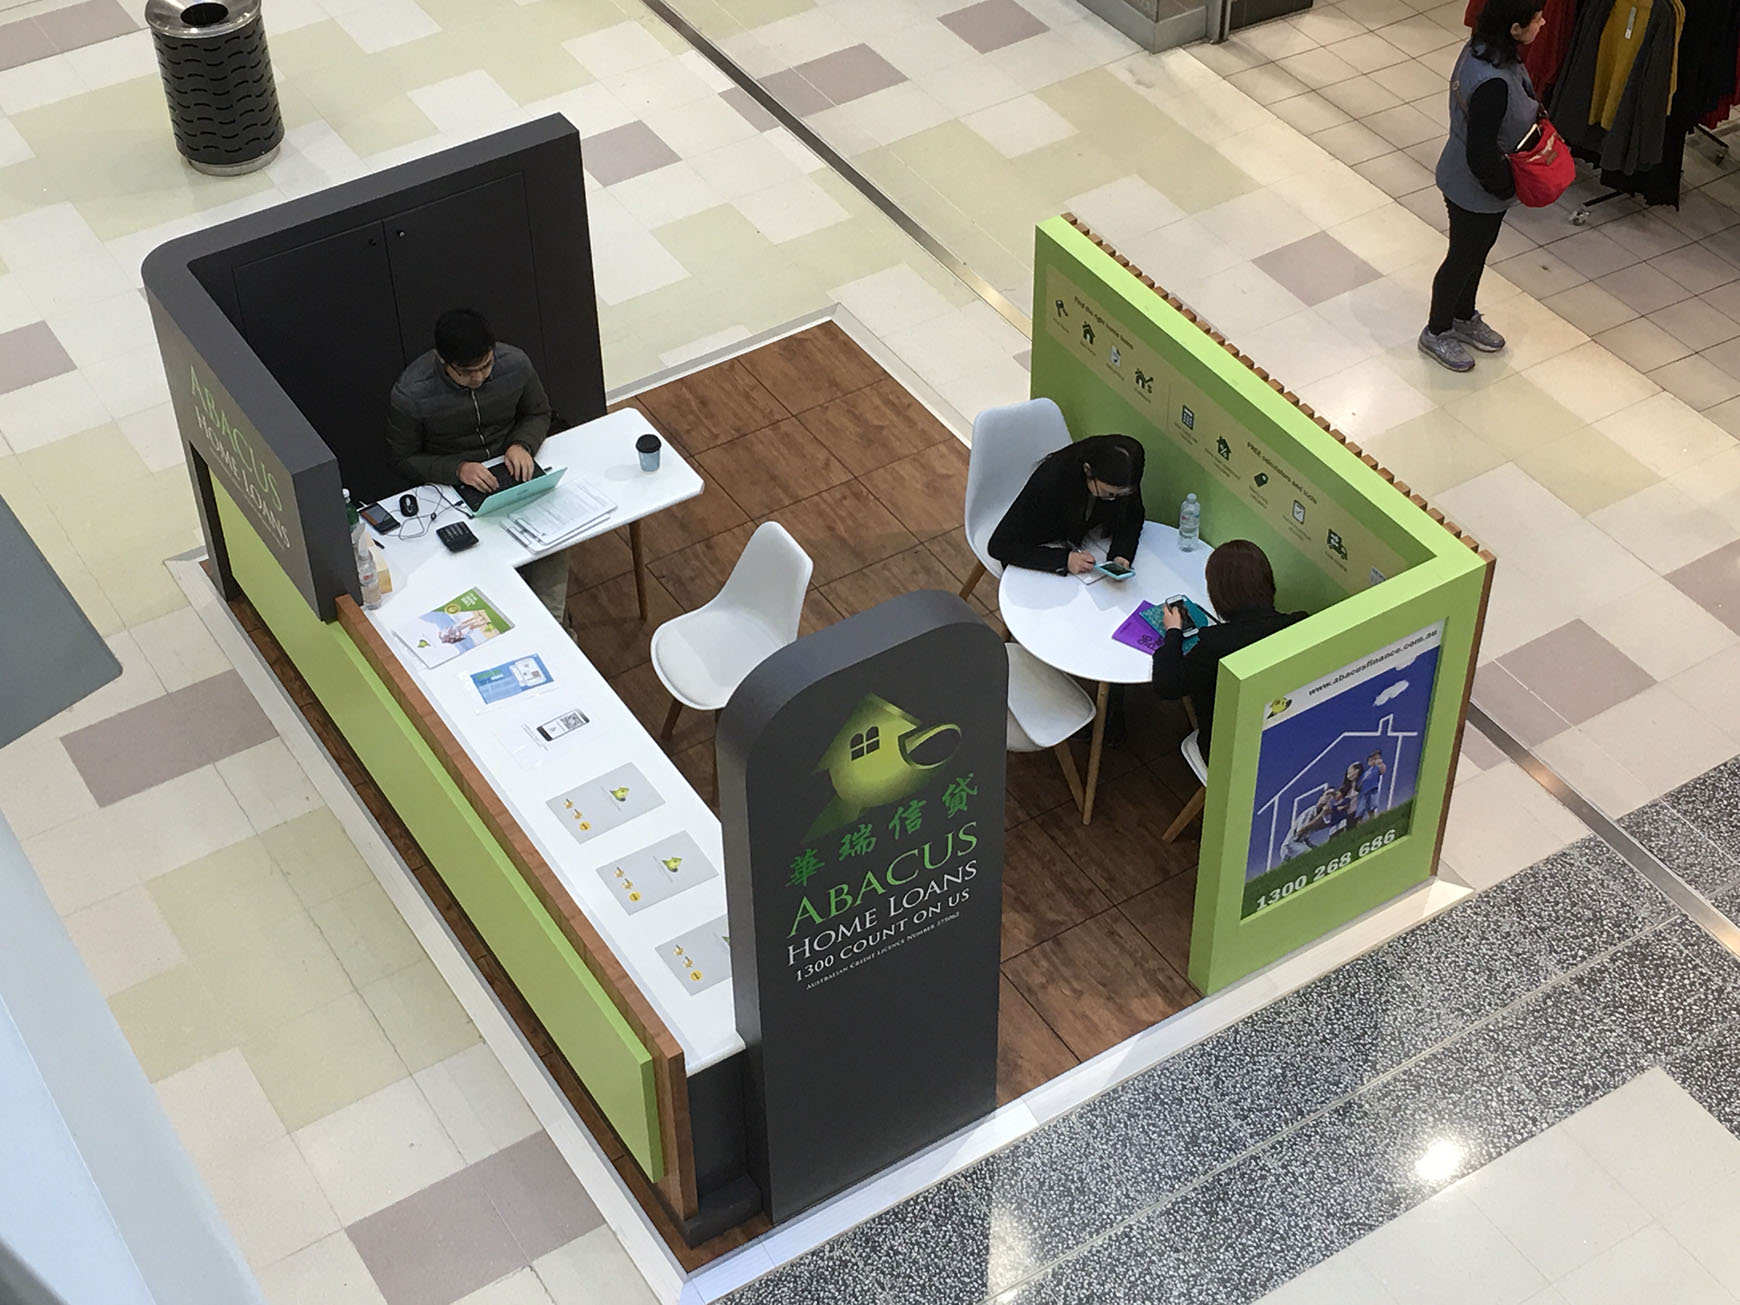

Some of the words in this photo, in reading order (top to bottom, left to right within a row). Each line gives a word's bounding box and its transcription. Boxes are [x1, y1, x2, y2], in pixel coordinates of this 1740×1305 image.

[190, 365, 282, 512] ABACUS
[194, 405, 241, 481] HOME
[242, 469, 291, 548] LOANS
[1308, 629, 1437, 696] www.abacusfinance.com.au
[786, 821, 977, 938] ABACUS
[787, 908, 878, 966] HOME
[889, 860, 977, 917] LOANS
[1256, 875, 1307, 911] 1300
[1313, 852, 1352, 881] 268
[1358, 829, 1396, 857] 686
[796, 955, 834, 982] 1300
[839, 918, 908, 959] COUNT
[913, 902, 941, 924] ON
[948, 888, 970, 907] US
[806, 967, 848, 990] AUSTRALIAN
[906, 924, 935, 941] NUMBER
